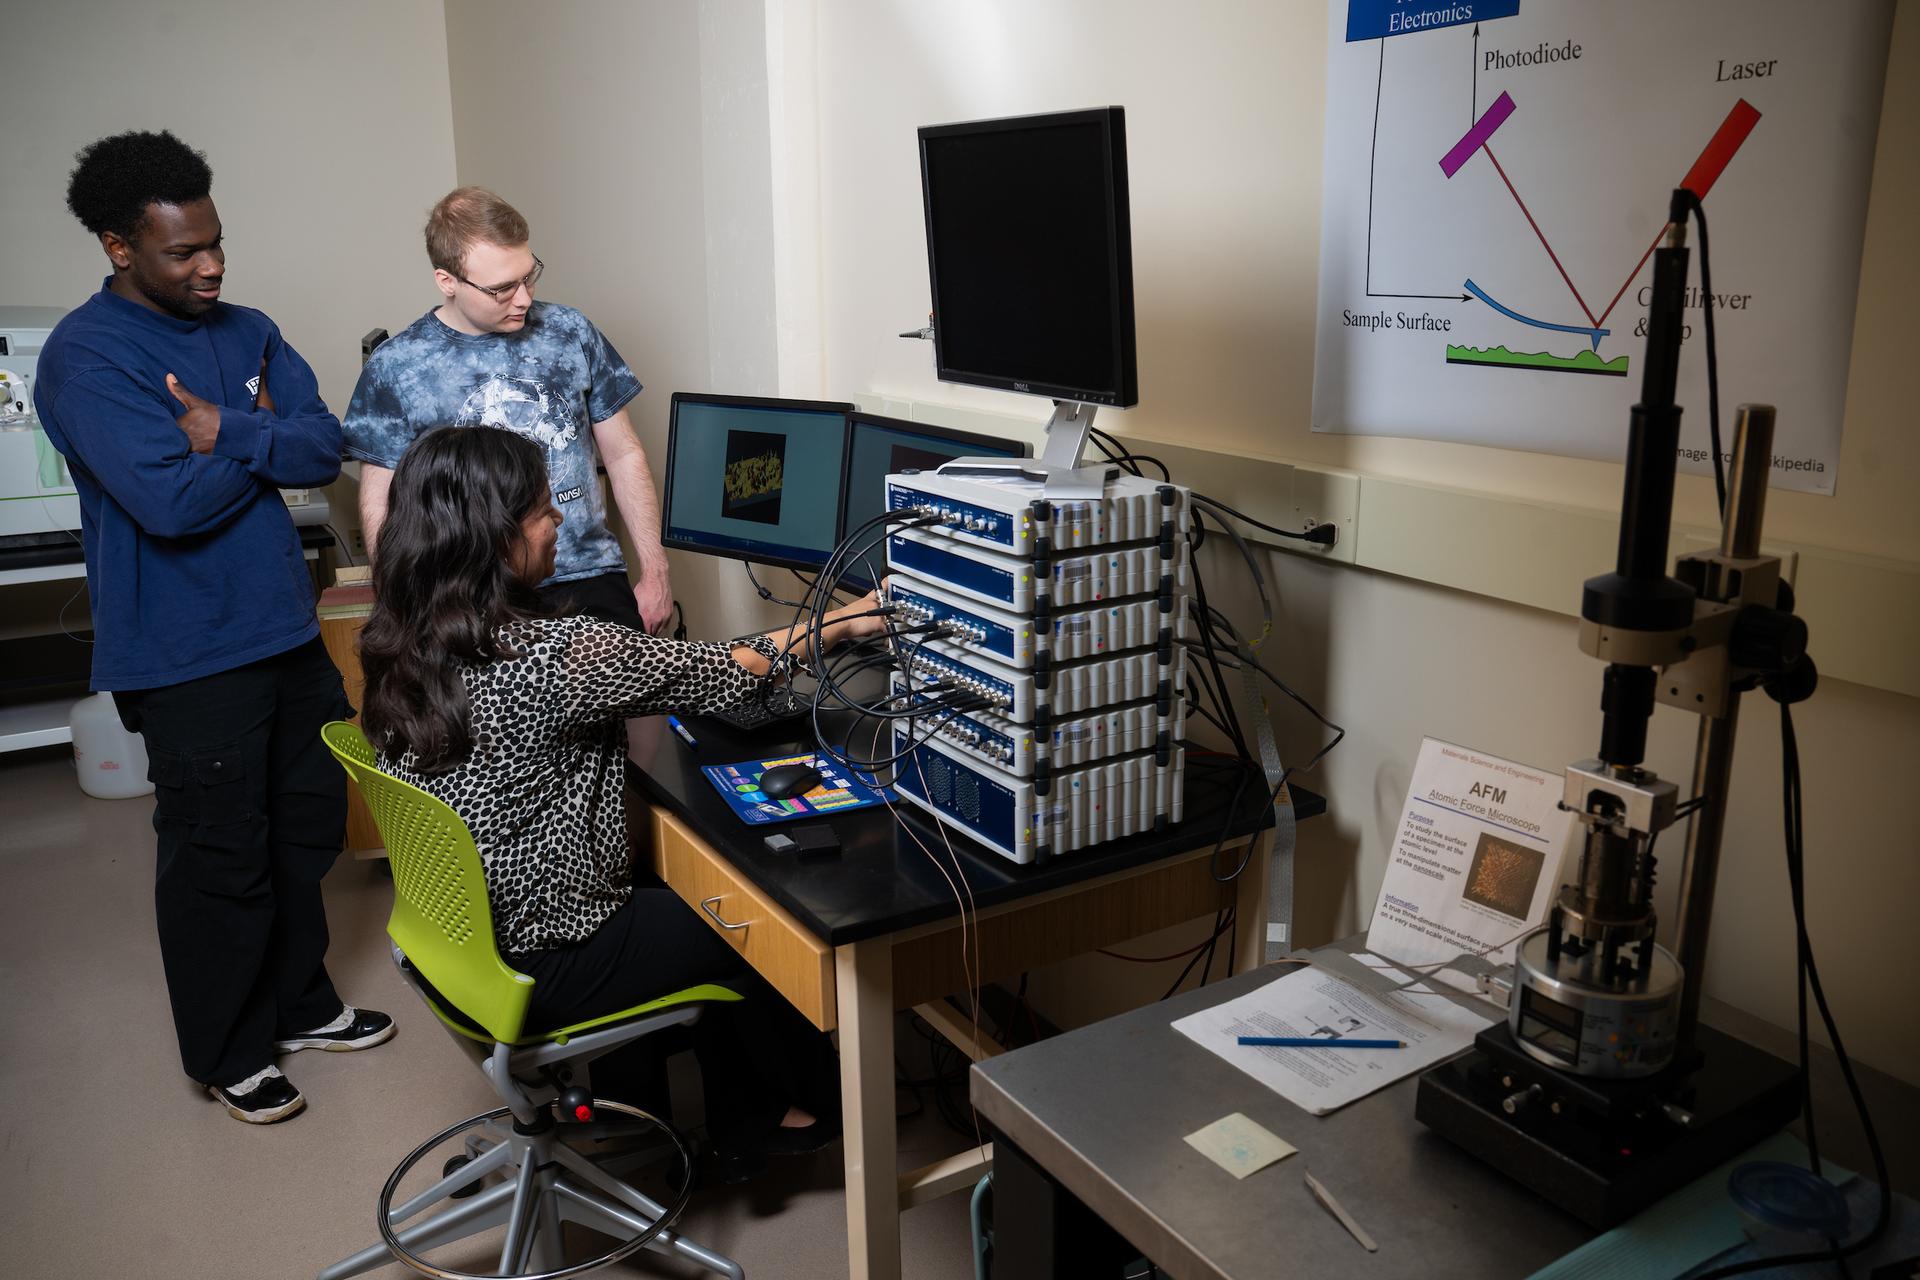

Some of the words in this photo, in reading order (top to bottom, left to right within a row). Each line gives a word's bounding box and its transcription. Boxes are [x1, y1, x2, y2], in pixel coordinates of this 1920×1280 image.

[1389, 2, 1473, 33] Electronics
[1484, 39, 1583, 71] Photodiode
[1715, 59, 1778, 82] Laser
[1637, 286, 1752, 310] Ciliver
[1343, 309, 1392, 332] Sample
[1396, 312, 1452, 332] Surface
[1633, 317, 1649, 337] &
[1677, 448, 1708, 462] mage
[1768, 454, 1825, 473] ikipedia
[558, 487, 583, 503] NASA
[1470, 756, 1494, 769] Science
[1494, 762, 1507, 773] and
[1507, 767, 1545, 785] Engineering
[1469, 781, 1507, 805] AFM
[1408, 811, 1434, 826] Purpose
[1428, 788, 1459, 807] Atomic
[1460, 798, 1486, 815] Force
[1488, 807, 1541, 833] Microscope
[1406, 820, 1414, 829] To
[1415, 825, 1432, 836] study
[1433, 831, 1443, 839] the
[1444, 835, 1468, 848] surface
[1416, 834, 1446, 849] specimen
[1453, 847, 1464, 856] the
[1401, 839, 1421, 850] atomic
[1422, 845, 1438, 856] level
[1399, 847, 1407, 856] To
[1407, 852, 1441, 869] manipulate
[1441, 864, 1462, 875] matter
[1402, 859, 1413, 868] the
[1385, 893, 1419, 913] Information
[1388, 904, 1401, 913] true
[1402, 907, 1457, 936] three-dimensional
[1457, 932, 1481, 945] surface
[1394, 917, 1408, 927] very
[1409, 922, 1425, 933] small
[1425, 928, 1442, 940] scale
